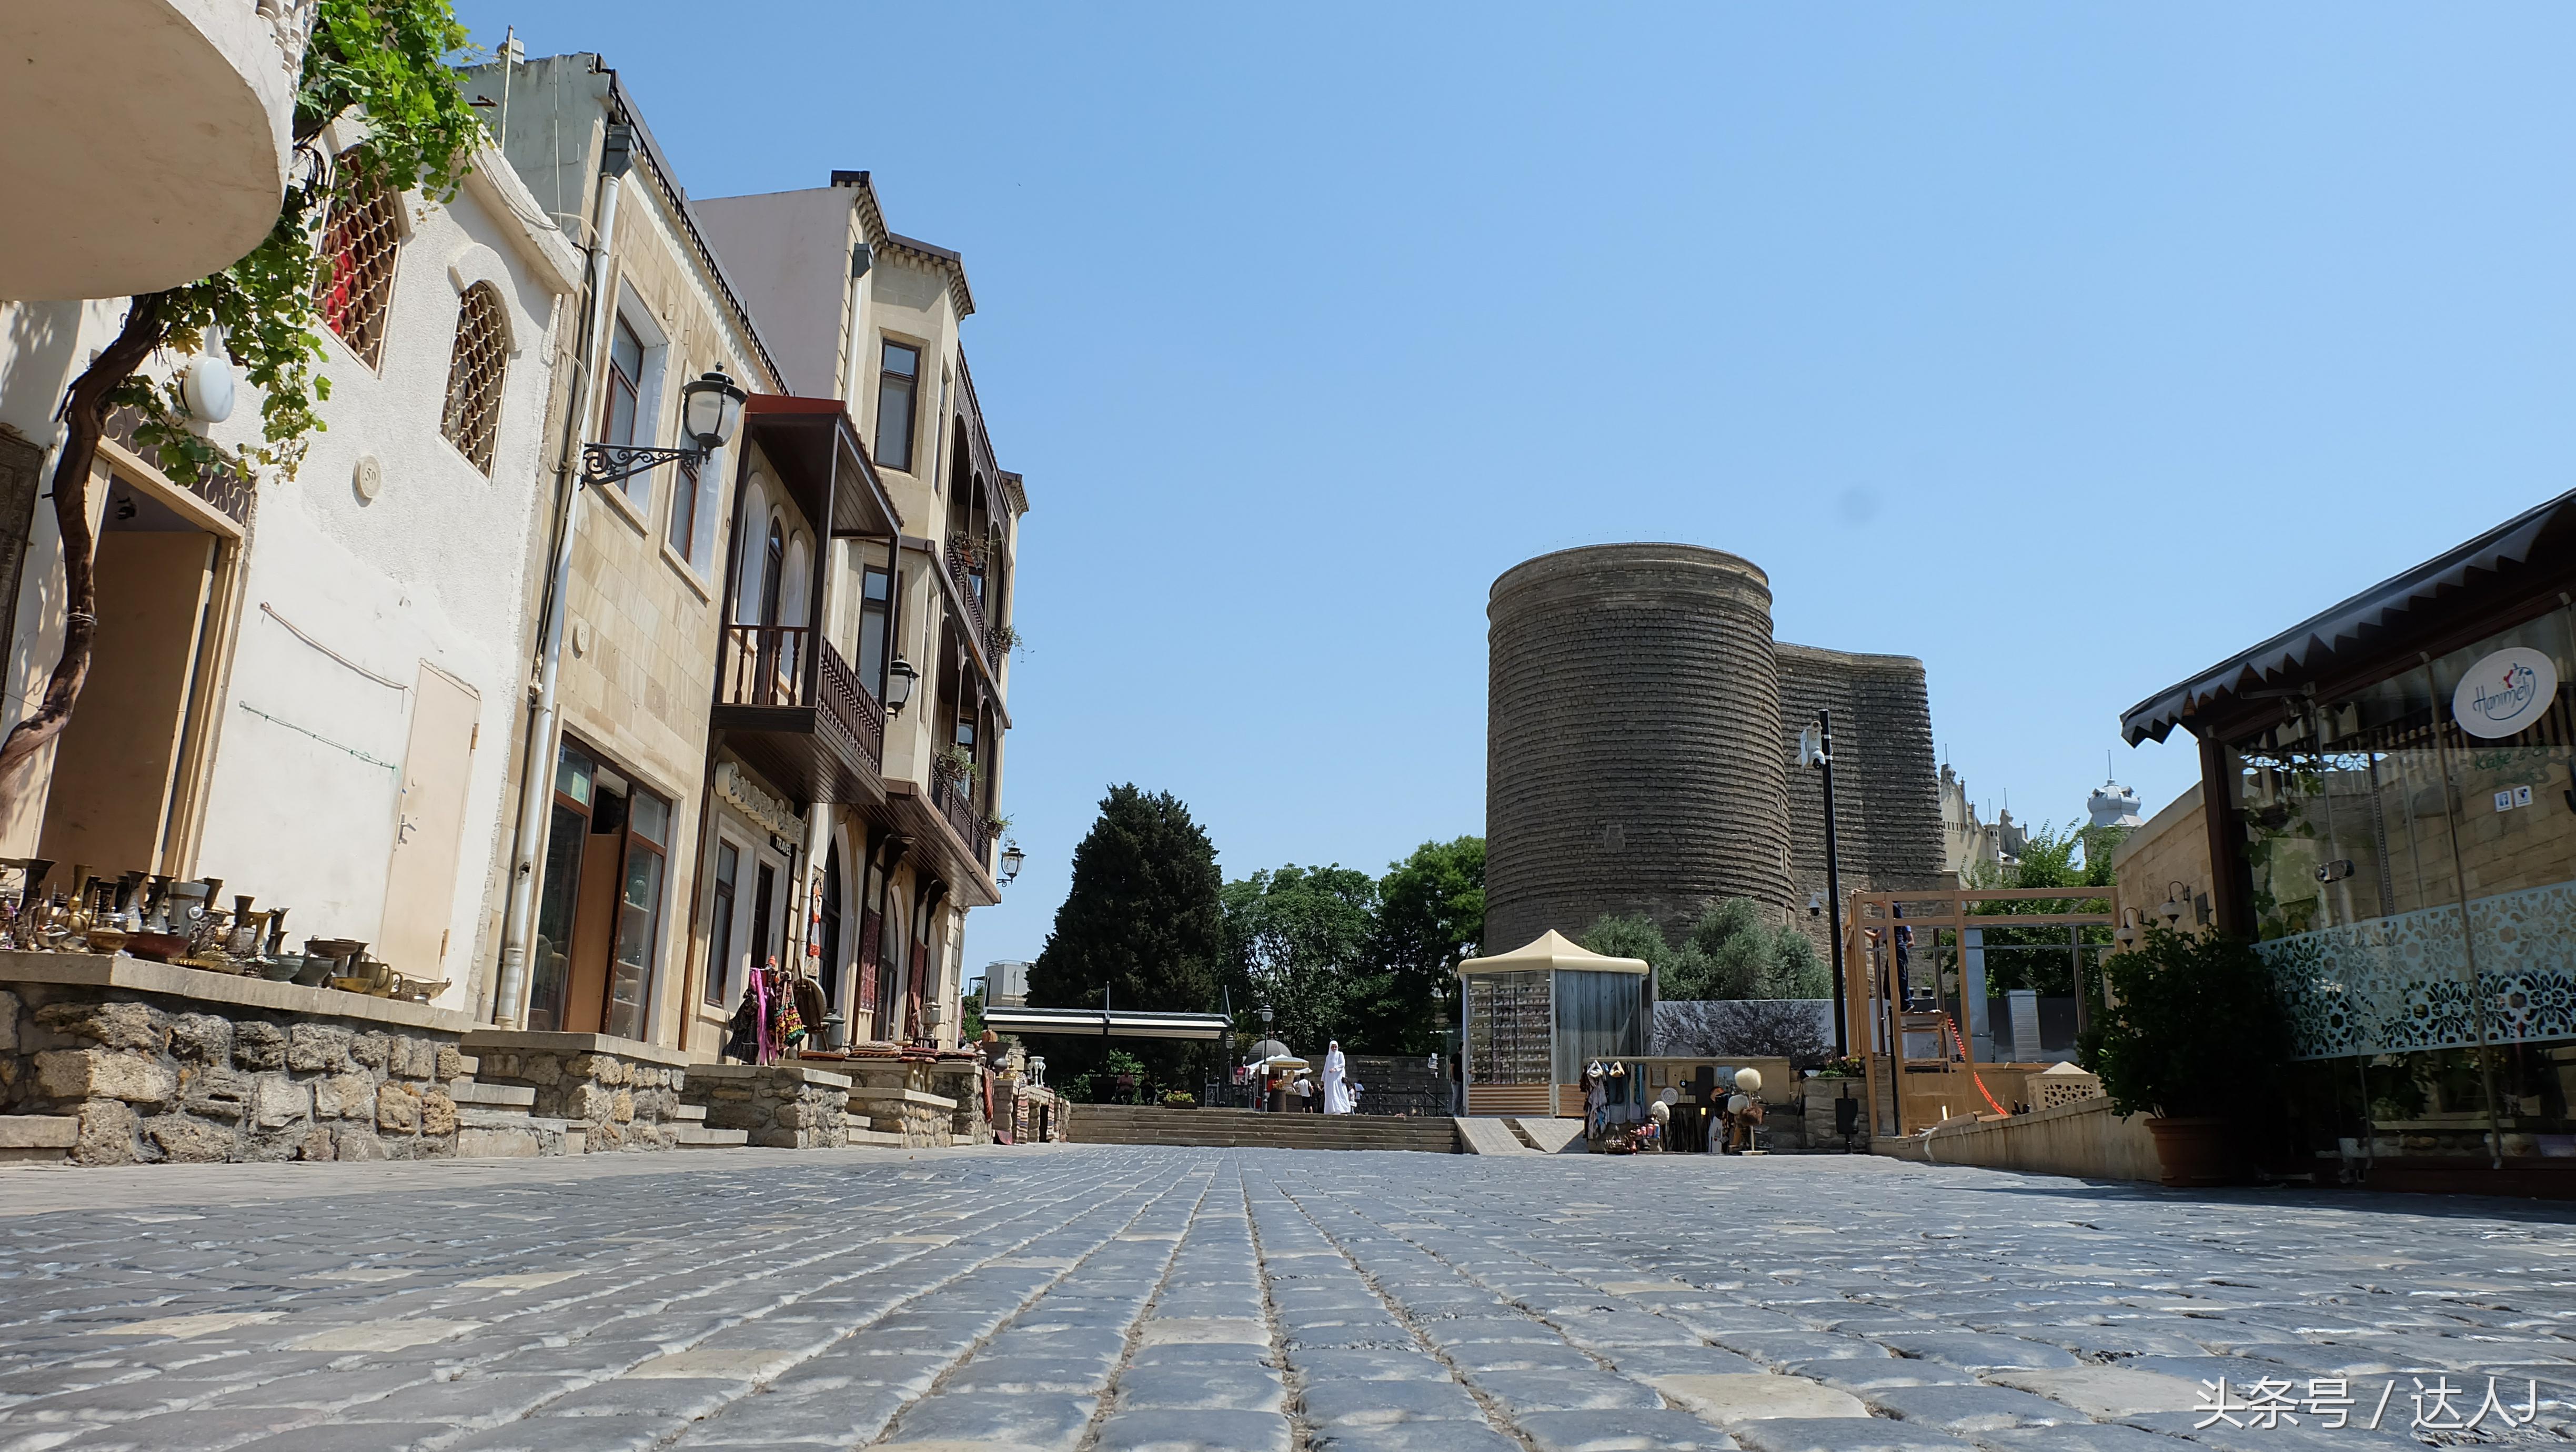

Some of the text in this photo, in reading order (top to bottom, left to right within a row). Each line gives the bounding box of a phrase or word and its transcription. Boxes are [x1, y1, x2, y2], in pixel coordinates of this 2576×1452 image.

[715, 761, 806, 848] GOLDEN GATE
[776, 836, 792, 857] TRAVEL
